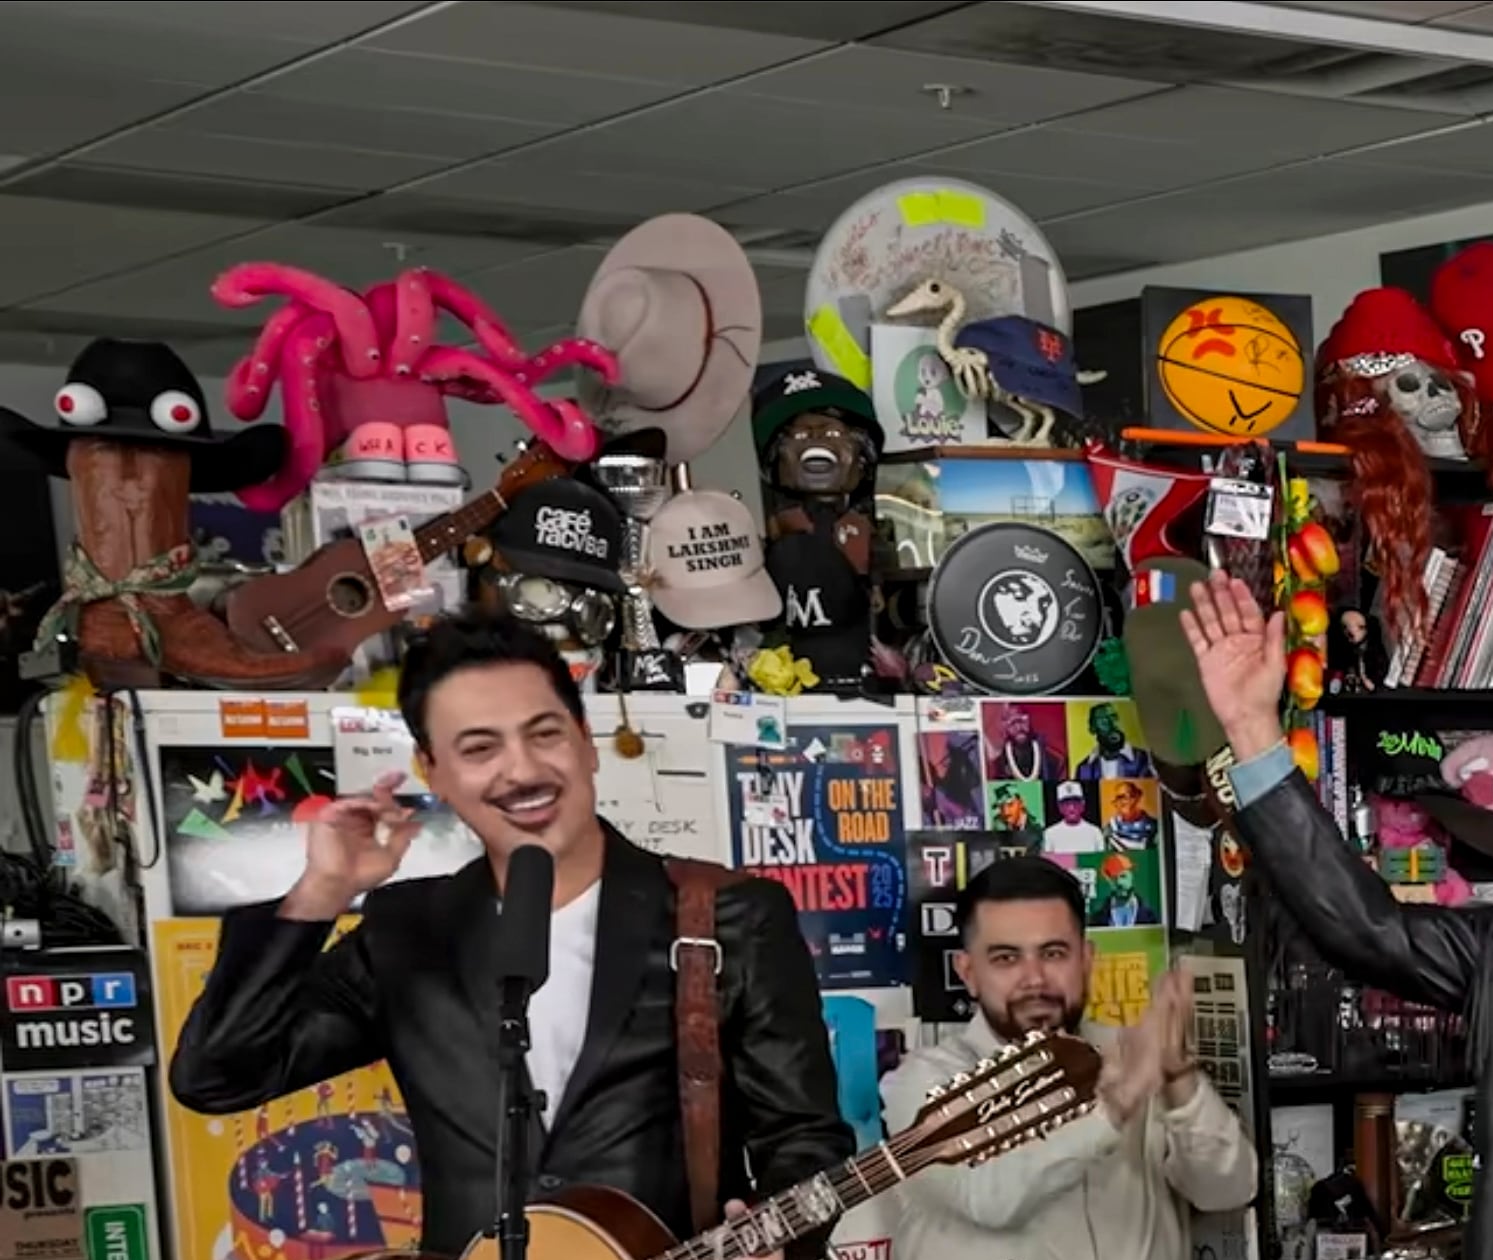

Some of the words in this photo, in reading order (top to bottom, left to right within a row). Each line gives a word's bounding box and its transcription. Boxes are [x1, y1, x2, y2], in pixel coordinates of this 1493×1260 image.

[905, 410, 960, 439] Louie
[688, 527, 695, 539] I
[699, 522, 730, 538] AM
[669, 536, 750, 559] LAKSHMI
[687, 553, 743, 573] SINGH
[828, 780, 854, 809] ON
[861, 778, 895, 809] THE
[649, 820, 697, 834] DESK
[742, 820, 816, 865] DESK
[838, 813, 889, 843] ROAD
[872, 865, 891, 886] 20
[18, 976, 120, 1006] npr
[17, 1013, 135, 1047] music
